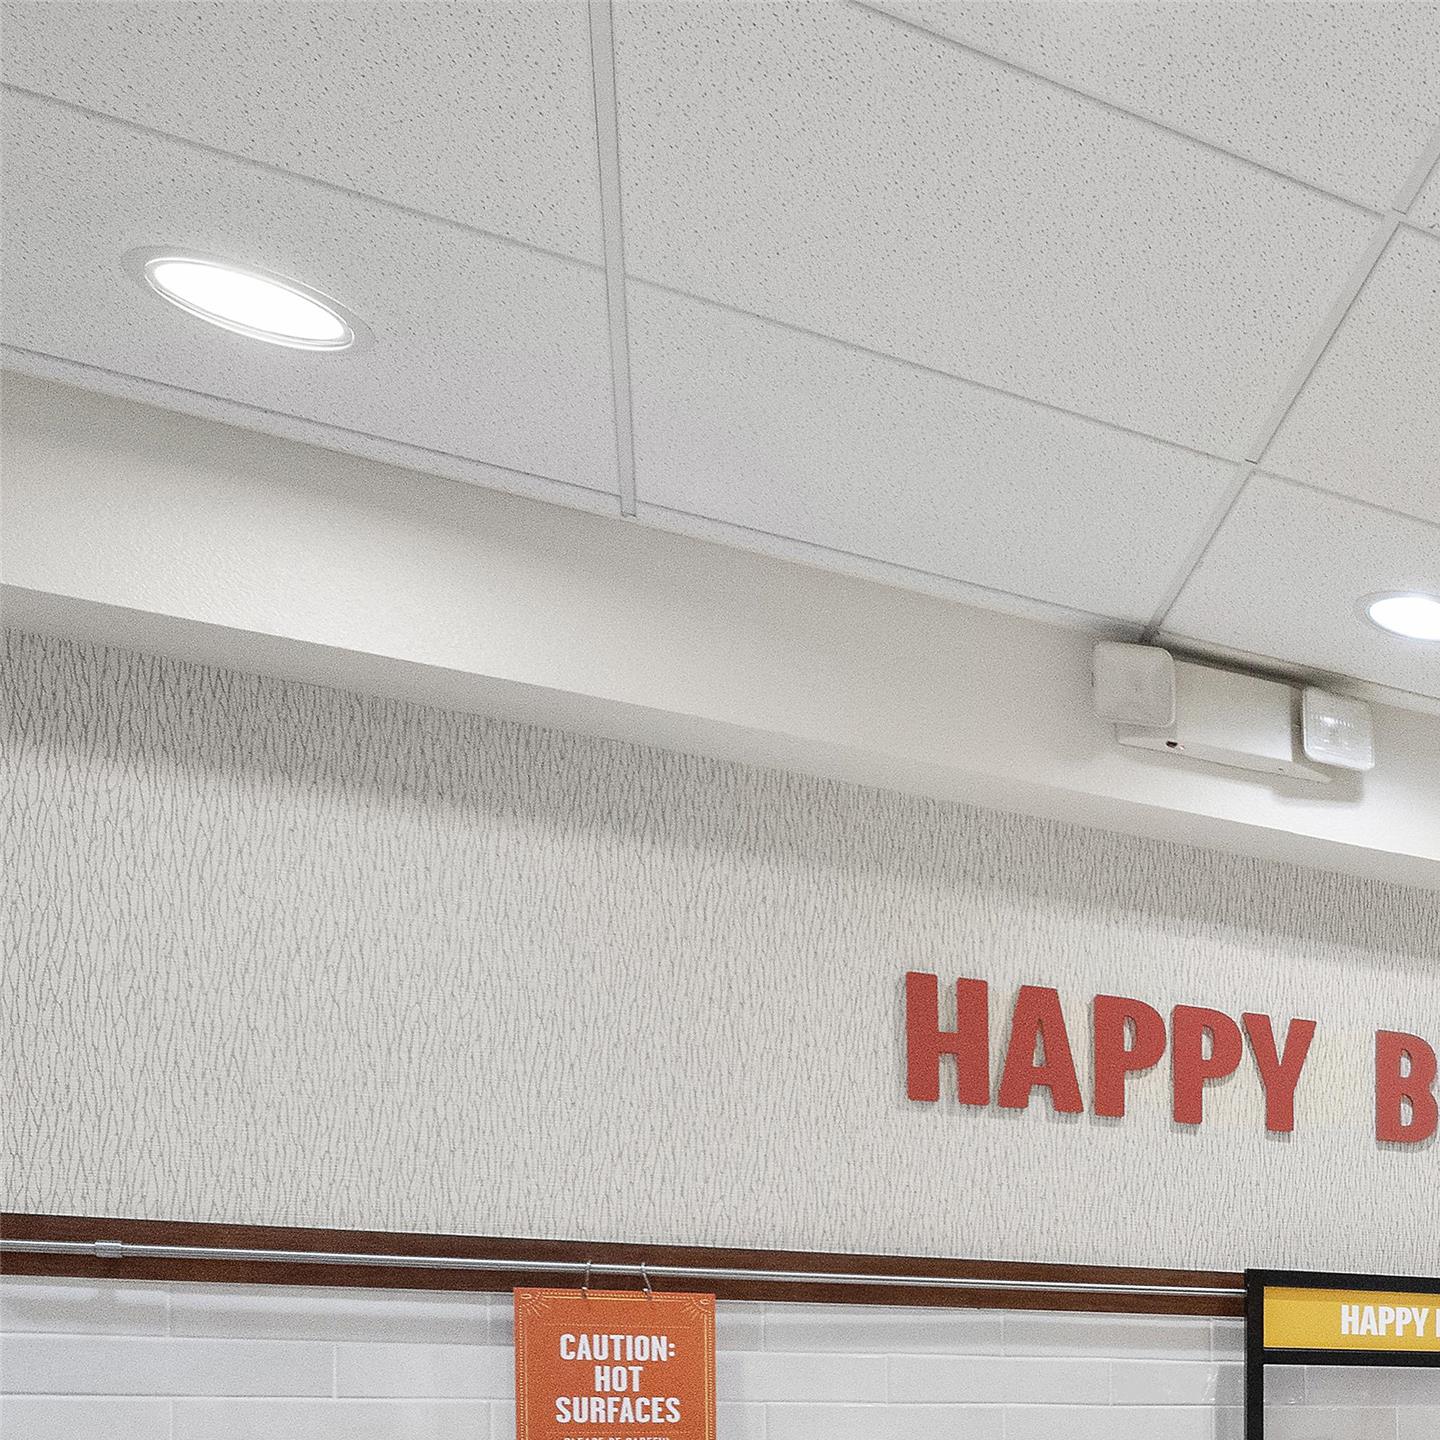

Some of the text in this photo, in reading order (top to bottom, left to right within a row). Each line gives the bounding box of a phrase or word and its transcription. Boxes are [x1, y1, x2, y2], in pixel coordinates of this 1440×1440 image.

[907, 973, 1314, 1132] HAPPY
[1341, 1304, 1428, 1337] HAPPY
[559, 1333, 676, 1362] CAUTION:
[594, 1365, 643, 1392] HOT
[555, 1396, 681, 1423] SURFACES
